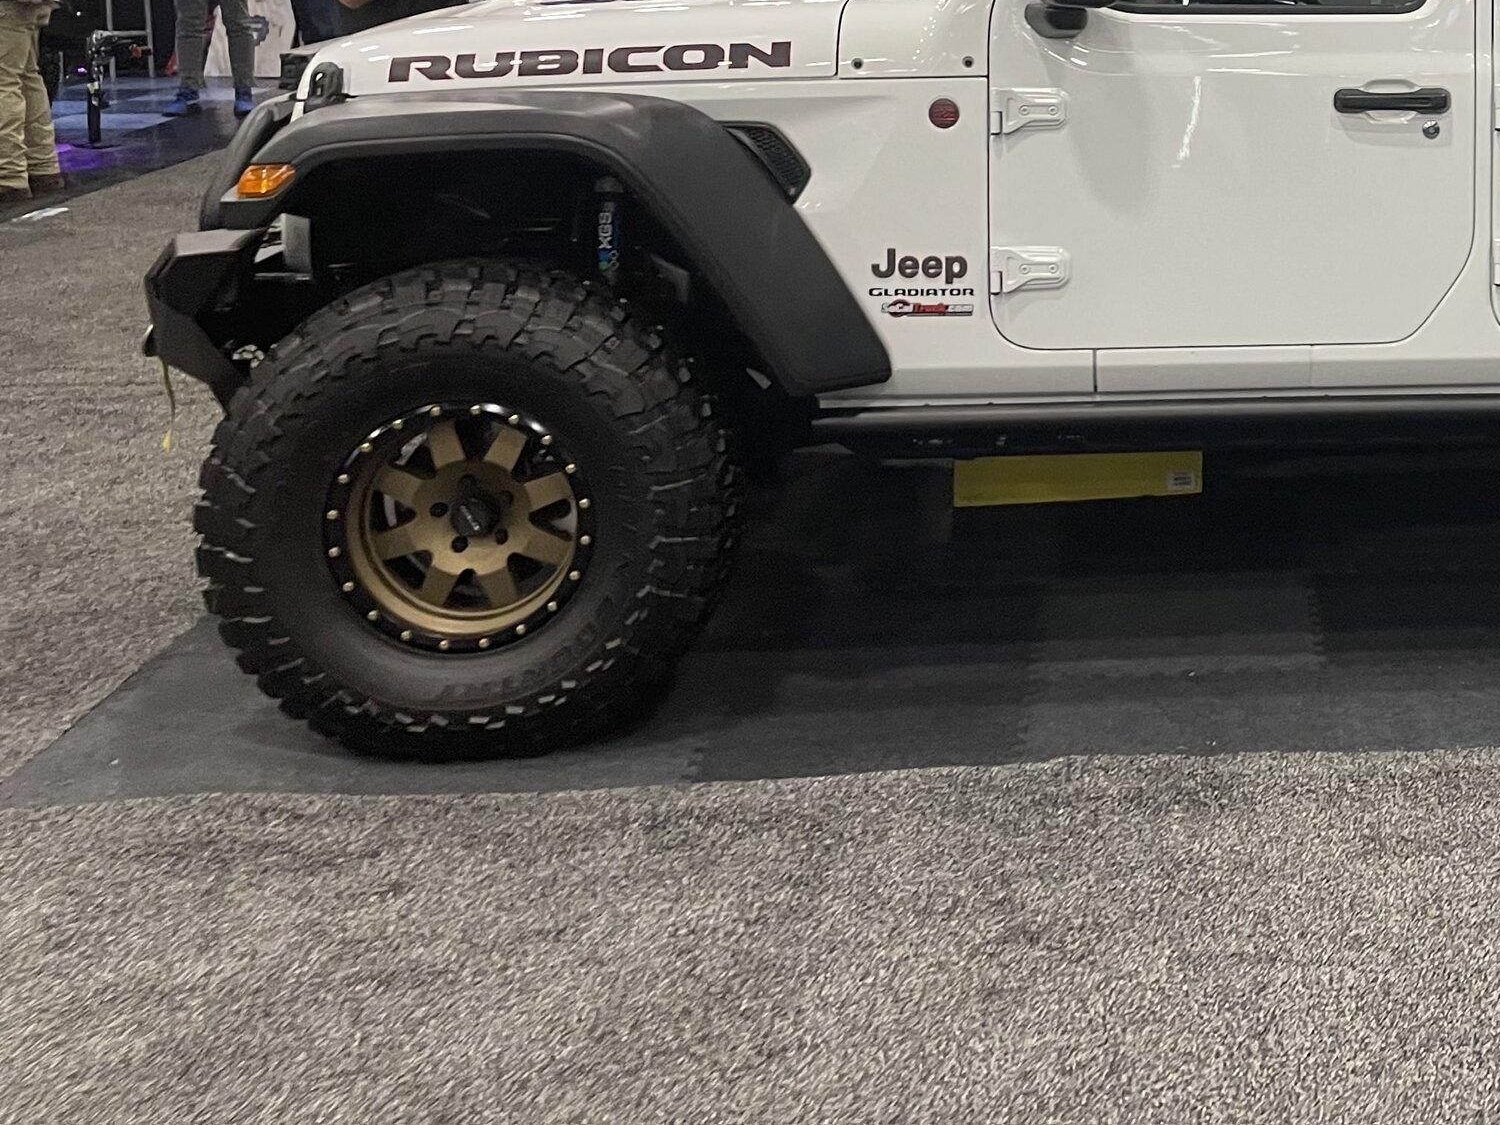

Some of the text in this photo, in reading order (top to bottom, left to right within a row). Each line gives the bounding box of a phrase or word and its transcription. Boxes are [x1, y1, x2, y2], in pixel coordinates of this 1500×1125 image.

[388, 41, 792, 83] RUBICON
[871, 248, 968, 284] Jeep
[868, 287, 975, 297] GLADIATOR
